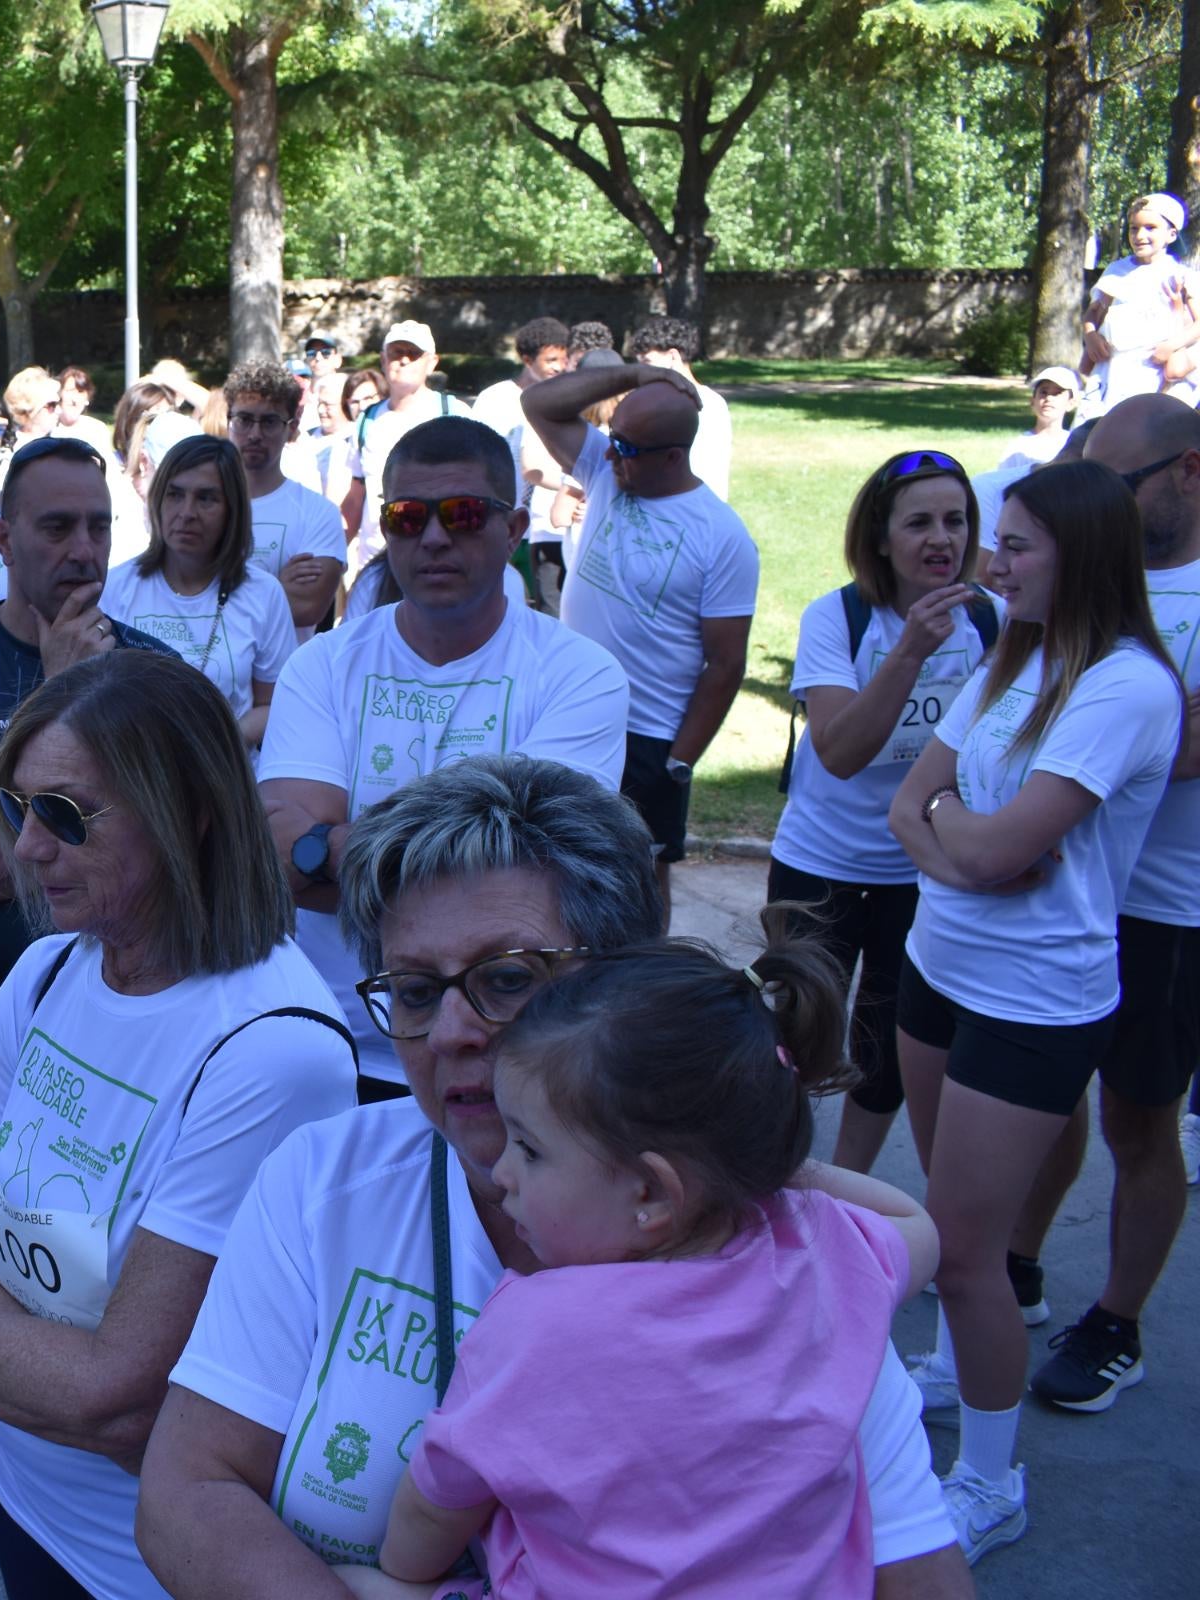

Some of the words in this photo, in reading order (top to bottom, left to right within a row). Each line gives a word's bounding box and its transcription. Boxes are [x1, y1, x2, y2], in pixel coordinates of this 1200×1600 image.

[146, 630, 194, 642] ALUDABLE
[153, 619, 186, 632] PASEO
[373, 685, 390, 702] IX
[397, 689, 456, 710] PASEO
[901, 696, 942, 727] 20
[39, 1055, 85, 1101] PASEO
[18, 1067, 87, 1129] SALUDABLE
[56, 1135, 72, 1152] San
[70, 1144, 108, 1175] Jerónimo
[358, 1296, 395, 1336] IX
[310, 1485, 326, 1500] ALBA
[327, 1494, 339, 1505] DE
[293, 1519, 315, 1538] EN
[320, 1532, 378, 1556] FAVOR
